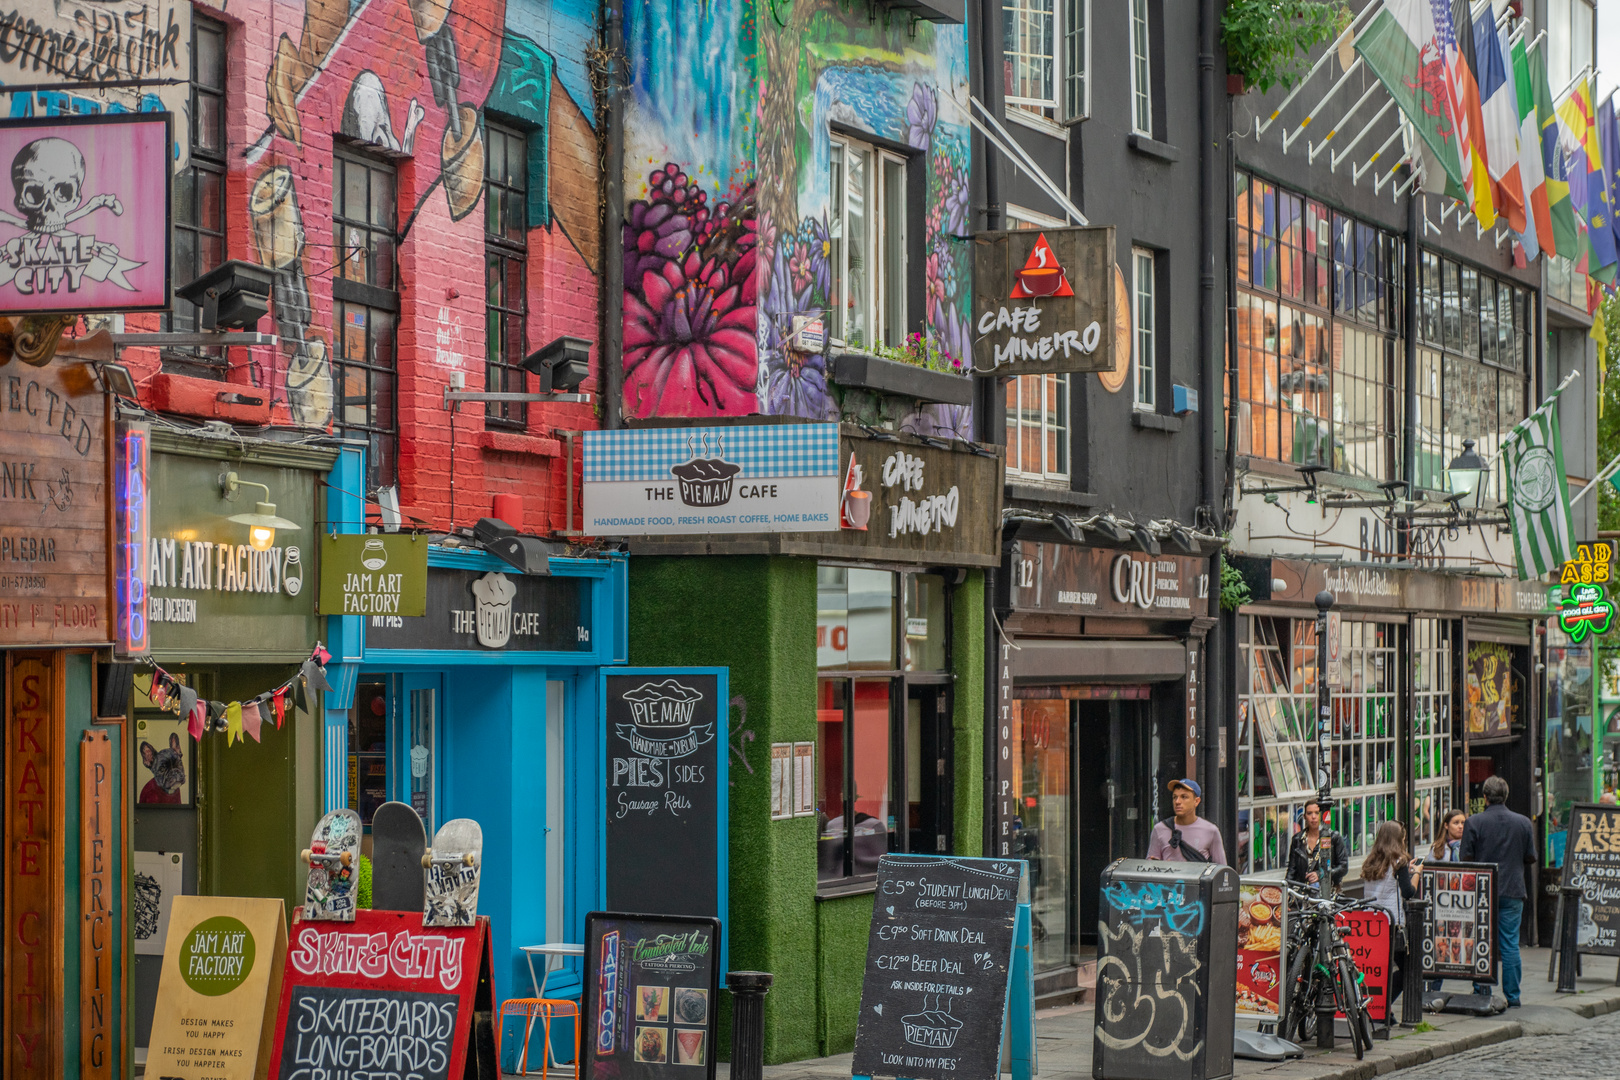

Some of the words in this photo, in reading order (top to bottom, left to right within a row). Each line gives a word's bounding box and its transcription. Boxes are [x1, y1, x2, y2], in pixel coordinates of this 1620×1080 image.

[6, 235, 96, 267] SKATE
[14, 264, 88, 295] CITY
[978, 307, 1042, 334] CAFE
[994, 321, 1101, 367] MINEIRO
[0, 376, 91, 457] ECTED
[882, 451, 925, 492] CAFE
[645, 487, 674, 501] THE
[682, 480, 731, 504] PIEMAN
[739, 485, 778, 499] CAFE
[594, 517, 645, 526] HANDMADE
[648, 516, 674, 527] FOOD,
[678, 516, 704, 525] FRESH
[708, 515, 736, 525] ROAST
[739, 514, 771, 524] COFFEE,
[774, 514, 799, 523] HOME
[802, 513, 829, 522] BAKES
[889, 486, 959, 539] MINEIRO
[1567, 543, 1612, 564] AD
[181, 541, 212, 590] ART
[216, 543, 281, 593] FACTORY
[1020, 559, 1033, 588] 12
[1157, 561, 1176, 573] TATTOO
[1561, 563, 1609, 584] ASS
[343, 573, 372, 592] JAM
[377, 574, 402, 593] ART
[1113, 554, 1156, 609] CRU
[1157, 578, 1179, 591] PIERCING
[1199, 573, 1209, 599] 12
[344, 593, 400, 613] FACTORY
[1058, 591, 1081, 604] BARBER
[1081, 592, 1098, 605] SHOP
[54, 604, 97, 628] FLOOR
[165, 598, 196, 623] DESIGN
[386, 616, 403, 628] PIES
[451, 610, 475, 633] THE
[513, 612, 540, 635] CAFE
[577, 626, 589, 642] 14a
[634, 702, 692, 724] PIEMAN
[1002, 644, 1010, 760] TATTOO
[632, 734, 668, 757] HANDMADE
[673, 737, 696, 756] DUBLIN
[17, 675, 45, 876] SKATE
[612, 757, 664, 787] PIES
[674, 765, 705, 783] SIDES
[615, 791, 659, 819] Sausage
[664, 790, 692, 817] Rolls
[1574, 853, 1606, 861] TEMPLE
[918, 877, 961, 898] STUDENT
[963, 882, 989, 900] LUNCH
[990, 885, 1014, 901] DEAL
[1437, 892, 1474, 909] CRU
[91, 763, 105, 1069] PIERCING
[915, 898, 946, 909] (BEFORE
[948, 900, 968, 911] 3PM)
[911, 925, 932, 941] SOFT
[934, 928, 958, 943] DRINK
[961, 928, 986, 944] DEAL
[1477, 876, 1489, 972] TATTOO
[190, 933, 218, 954] JAM
[222, 934, 245, 954] ART
[633, 932, 688, 961] Connected
[688, 930, 709, 954] Ink
[1350, 945, 1372, 959] ody
[189, 956, 245, 976] FACTORY
[291, 928, 388, 978] SKATE
[389, 929, 466, 990] CITY
[911, 955, 937, 973] BEER
[940, 959, 965, 975] DEAL
[16, 911, 42, 1069] CITY
[600, 936, 617, 1047] TATTOO
[890, 980, 902, 990] ASK
[904, 982, 924, 992] INSIDE
[923, 983, 935, 993] FOR
[936, 984, 963, 995] DETAILS
[180, 1018, 207, 1026] DESIGN
[211, 1020, 234, 1028] MAKES
[297, 996, 456, 1040] SKATEBOARDS
[203, 1031, 225, 1039] HAPPY
[907, 1025, 952, 1046] PIEMAN
[163, 1047, 185, 1055] IRISH
[189, 1048, 216, 1056] DESIGN
[176, 1059, 190, 1067] YOU
[295, 1034, 447, 1073] LONGBOARDS
[905, 1056, 923, 1068] INTO
[925, 1058, 937, 1068] MY
